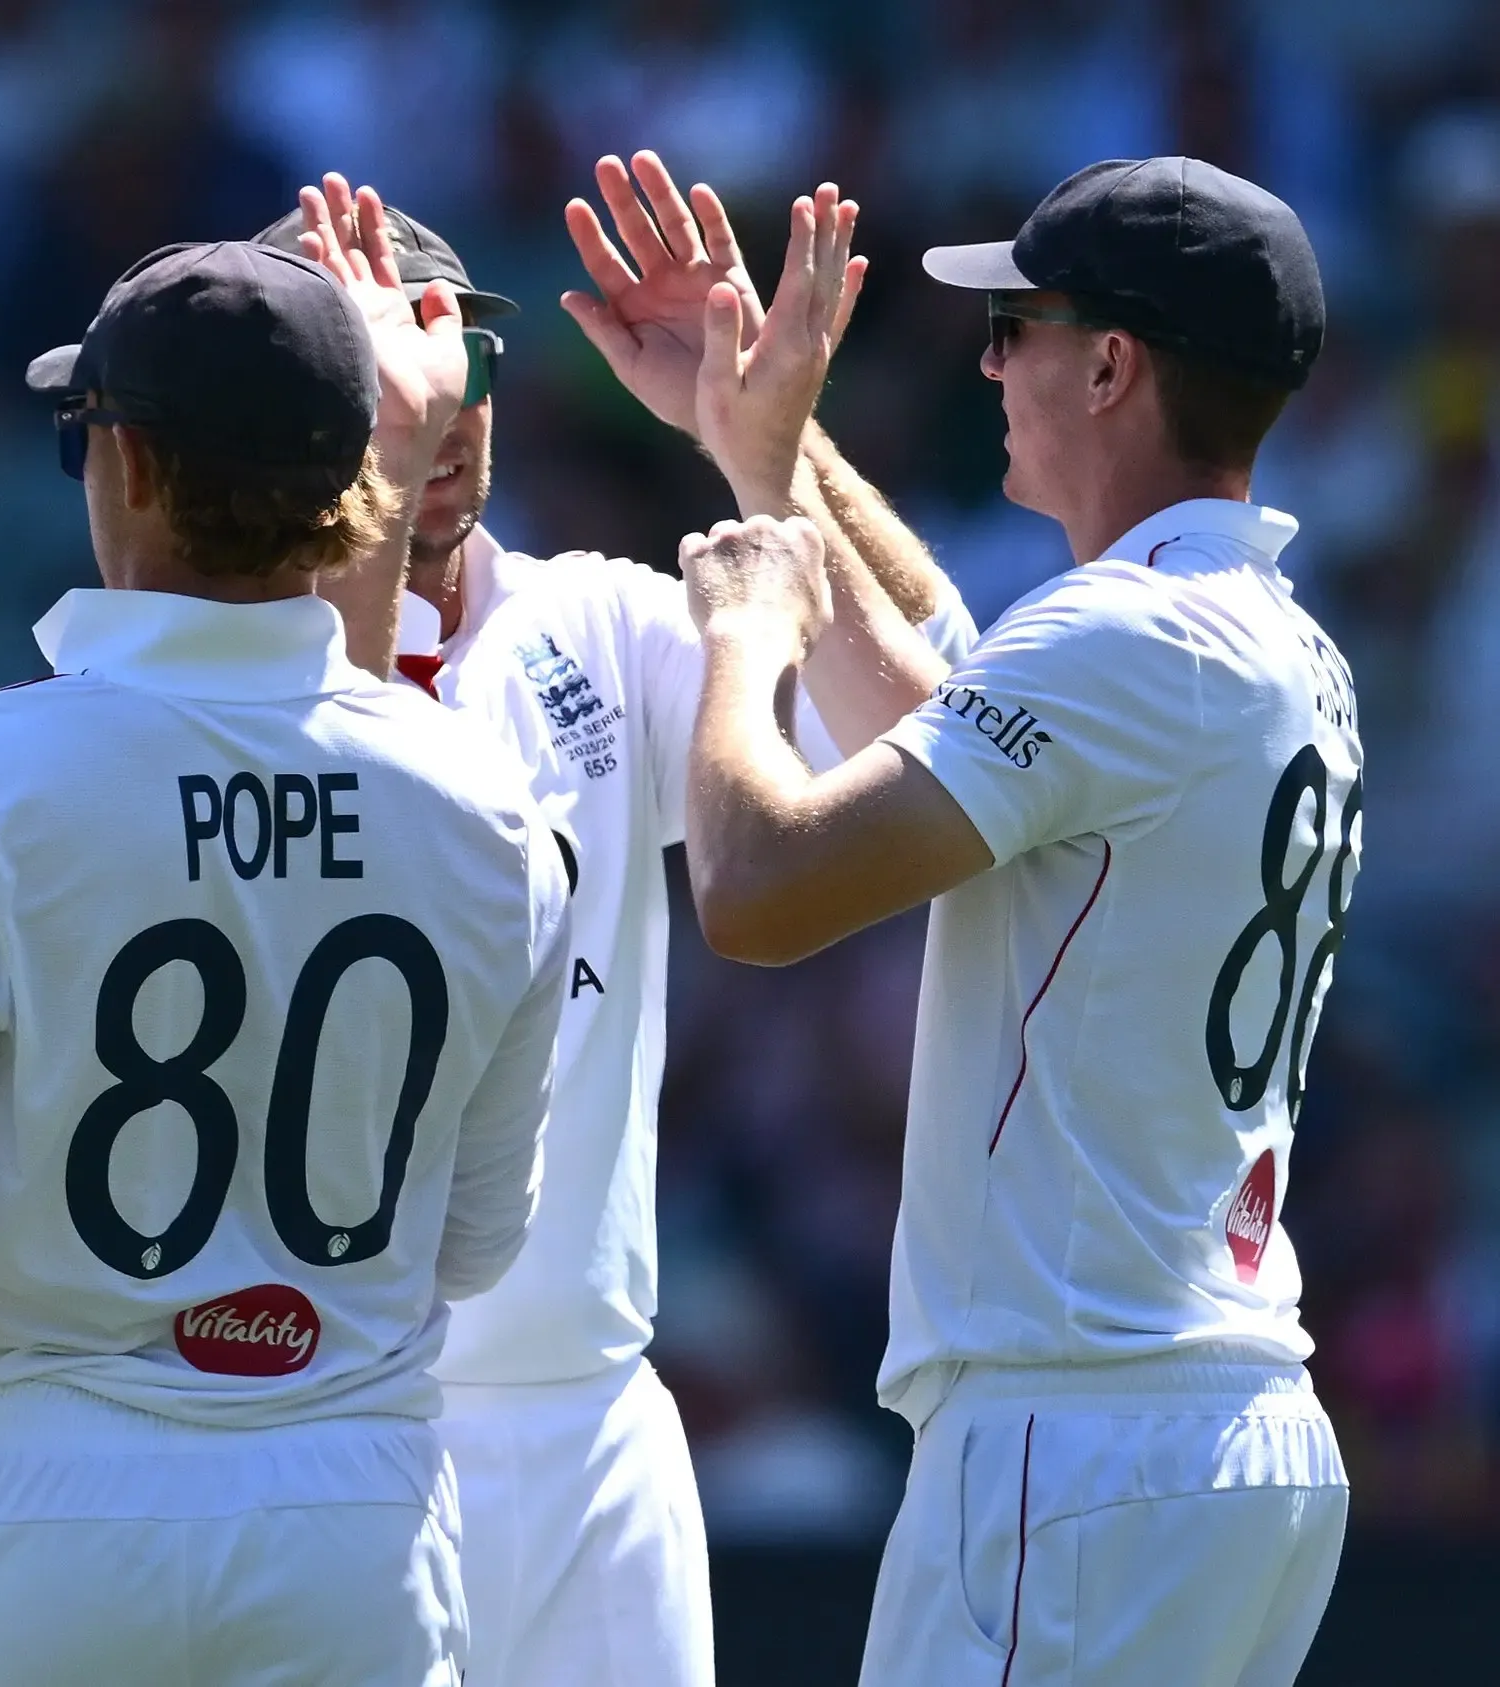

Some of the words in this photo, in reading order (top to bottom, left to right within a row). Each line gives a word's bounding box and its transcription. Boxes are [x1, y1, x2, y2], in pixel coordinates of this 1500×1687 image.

[582, 704, 626, 736] SERIE
[583, 752, 618, 779] 655
[177, 771, 364, 882] POPE
[65, 912, 450, 1281] 80
[1226, 1182, 1268, 1262] Vitality
[183, 1304, 314, 1364] Vitality
